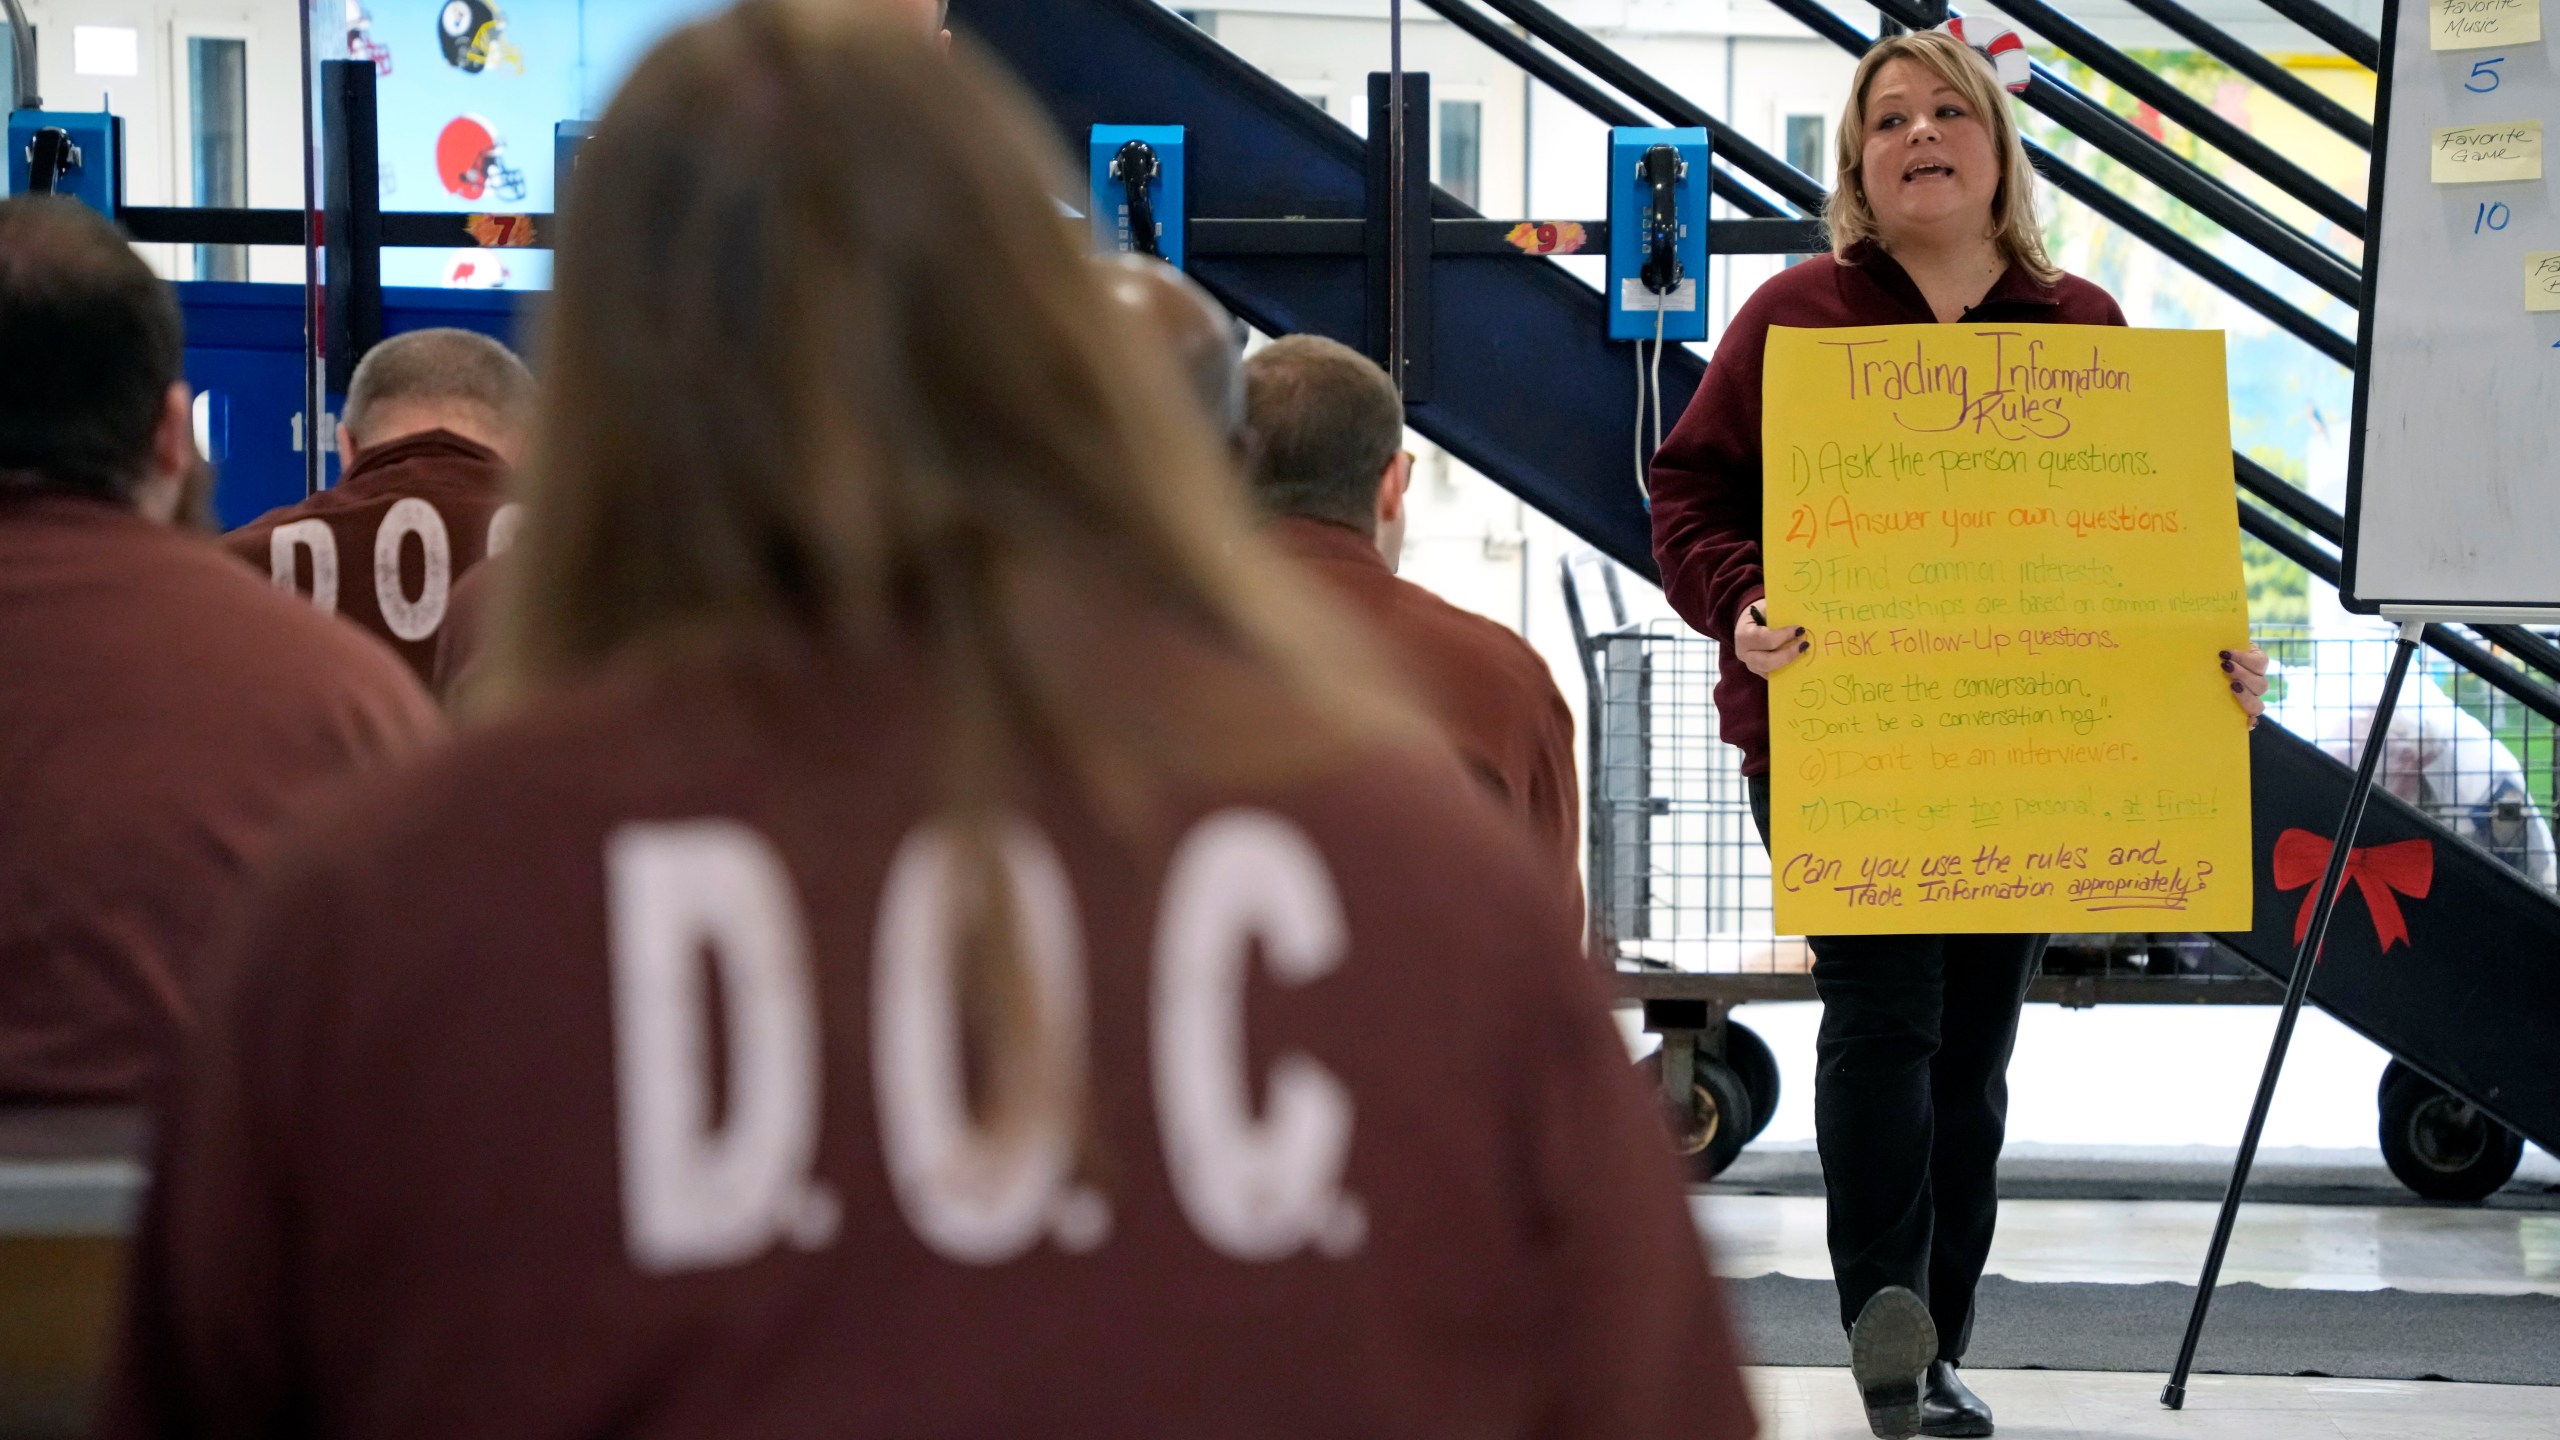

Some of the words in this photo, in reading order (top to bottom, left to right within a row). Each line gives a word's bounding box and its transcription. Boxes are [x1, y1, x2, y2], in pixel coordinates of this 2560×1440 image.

[2444, 17, 2499, 38] Music
[2464, 57, 2505, 93] 5
[2441, 128, 2533, 151] Favorite
[2450, 148, 2521, 163] Game
[494, 215, 516, 246] 7
[2474, 201, 2511, 234] 10
[1536, 223, 1557, 253] 9
[1818, 339, 1968, 433] Trading
[1975, 332, 2132, 398] Information
[1966, 391, 2071, 441] Rules
[1819, 441, 1882, 494] Ask
[1889, 442, 1925, 476] the
[1928, 447, 2028, 491] person
[2038, 443, 2158, 489] questions.
[1786, 503, 1817, 549] 2)
[1825, 495, 1926, 547] Answer
[1942, 509, 1997, 548] your
[2008, 506, 2056, 532] own
[2067, 500, 2188, 539] questions.
[1784, 558, 1823, 595] 3)
[1826, 554, 1890, 595] Find
[1907, 560, 2006, 585] common
[2020, 552, 2123, 588] interests.
[1975, 596, 2013, 615] are
[2019, 589, 2067, 616] based
[2073, 599, 2097, 615] on
[2101, 597, 2163, 614] common
[1824, 630, 1882, 657] Ask
[1889, 625, 2012, 657] Follow-Up
[2018, 626, 2120, 656] questions.
[1794, 678, 1827, 711] 5)
[1830, 674, 1897, 706] Share
[1900, 673, 1943, 702] the
[1953, 671, 2092, 699] conversation.
[1876, 711, 1900, 733] be
[1910, 713, 1925, 728] a
[1938, 704, 2054, 728] conversation
[1799, 747, 1827, 788] 6)
[1827, 743, 1912, 780] Don't
[1930, 743, 1961, 770] be
[1967, 748, 1996, 767] an
[2007, 736, 2139, 766] interviewer.
[1801, 796, 1829, 834] 7)
[1833, 796, 1907, 830] Don't
[1916, 797, 1959, 832] get
[1968, 796, 2005, 820] too
[2121, 795, 2144, 816] at
[2155, 786, 2218, 817] first!
[1782, 852, 1842, 893] Can
[1861, 856, 1910, 888] you
[1920, 854, 1962, 877] use
[1971, 844, 2010, 876] the
[2026, 842, 2089, 870] rules
[2108, 839, 2167, 866] and
[1833, 882, 1904, 908] Trade
[1917, 875, 2055, 903] Information
[2067, 860, 2214, 906] appropriately?
